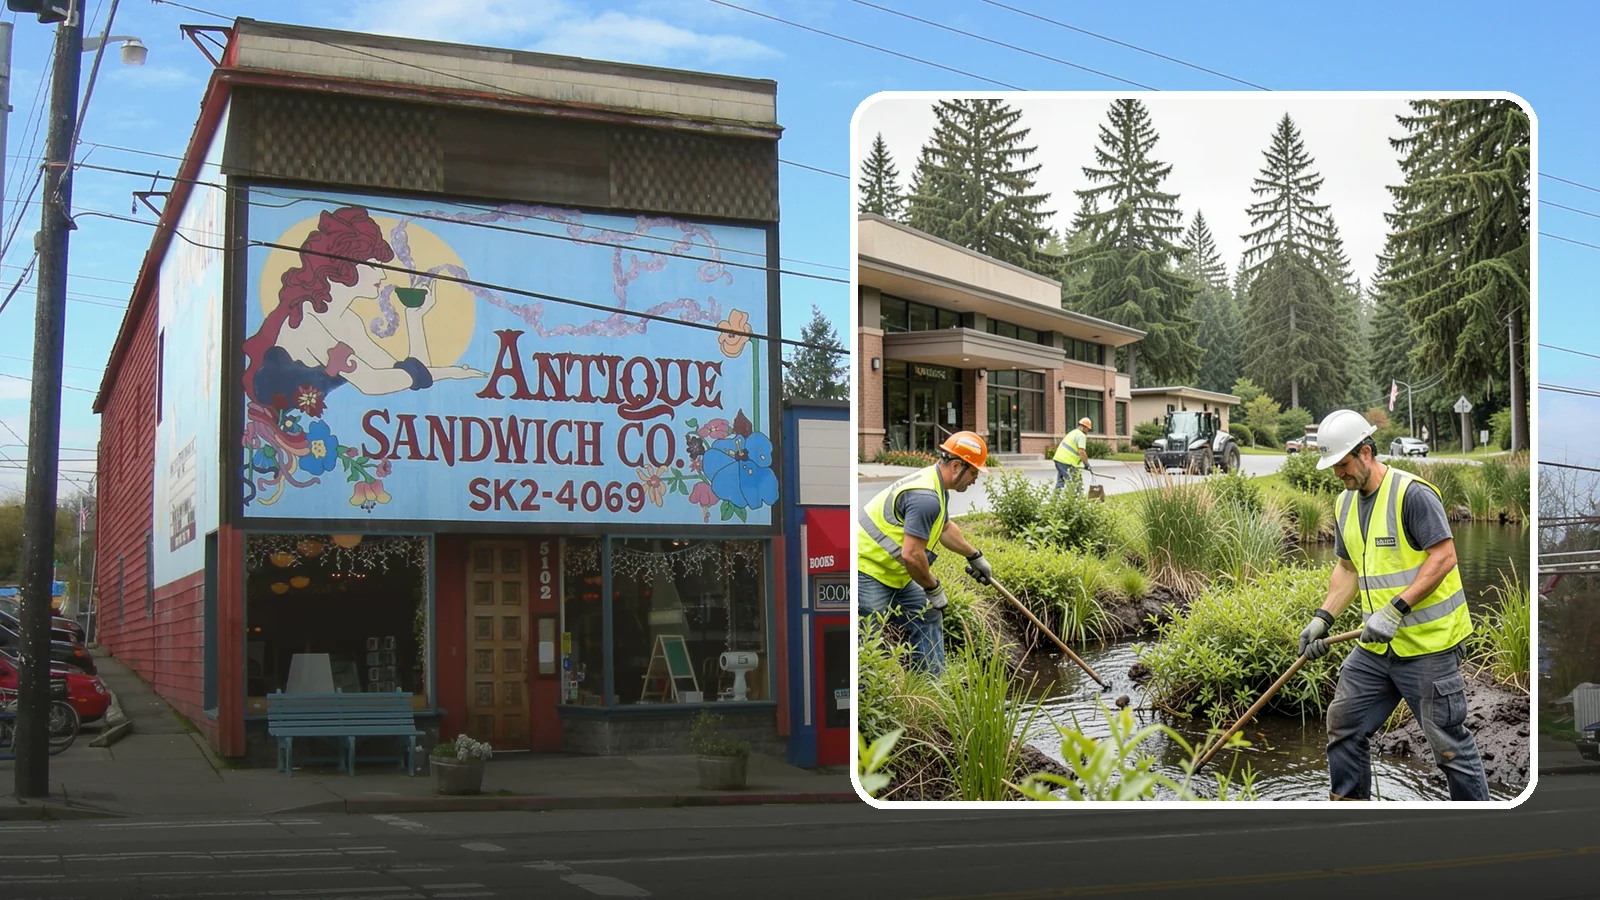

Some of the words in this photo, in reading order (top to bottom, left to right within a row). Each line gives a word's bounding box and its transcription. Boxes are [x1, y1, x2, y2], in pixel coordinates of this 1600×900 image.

[476, 329, 723, 421] ANTIQUE
[361, 408, 604, 467] SANDWICH
[617, 422, 684, 468] CO.
[468, 477, 646, 513] SK2-4069
[539, 541, 552, 599] 5102
[809, 555, 835, 569] BOOKS
